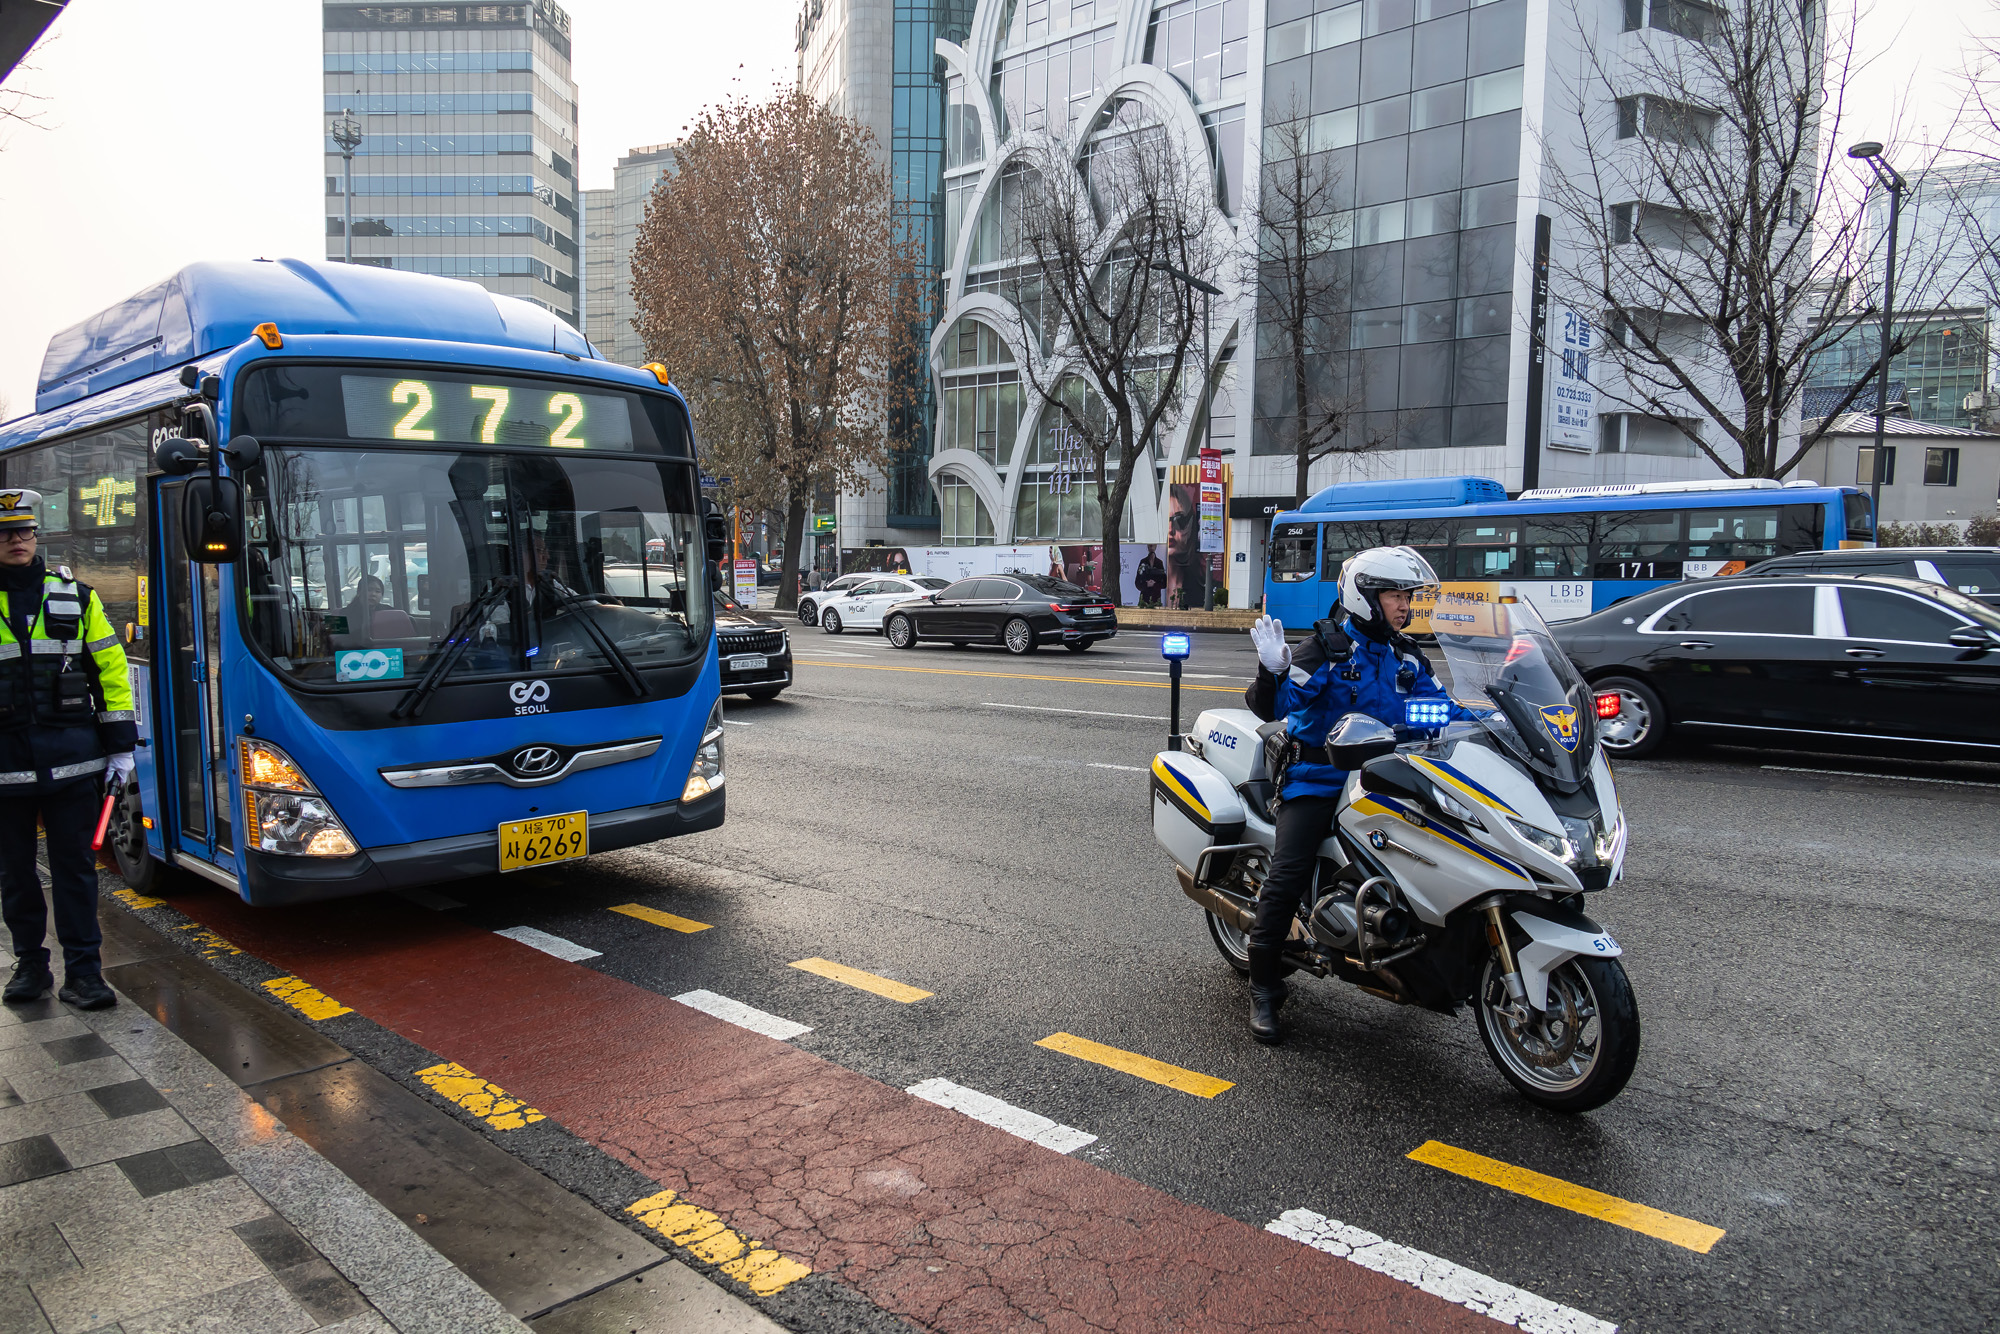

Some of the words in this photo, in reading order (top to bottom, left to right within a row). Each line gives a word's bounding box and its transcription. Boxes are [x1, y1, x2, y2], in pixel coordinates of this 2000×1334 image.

[1565, 311, 1590, 348] 건물
[1557, 386, 1591, 403] 02.723.3333
[1049, 423, 1083, 451] The
[1048, 465, 1073, 495] in
[1619, 563, 1654, 578] 171
[1687, 563, 1707, 572] LBB
[1550, 584, 1584, 597] LBB
[514, 704, 550, 716] SEOUL
[1208, 730, 1238, 750] POLICE
[522, 822, 542, 834] 서울
[548, 818, 566, 832] 70
